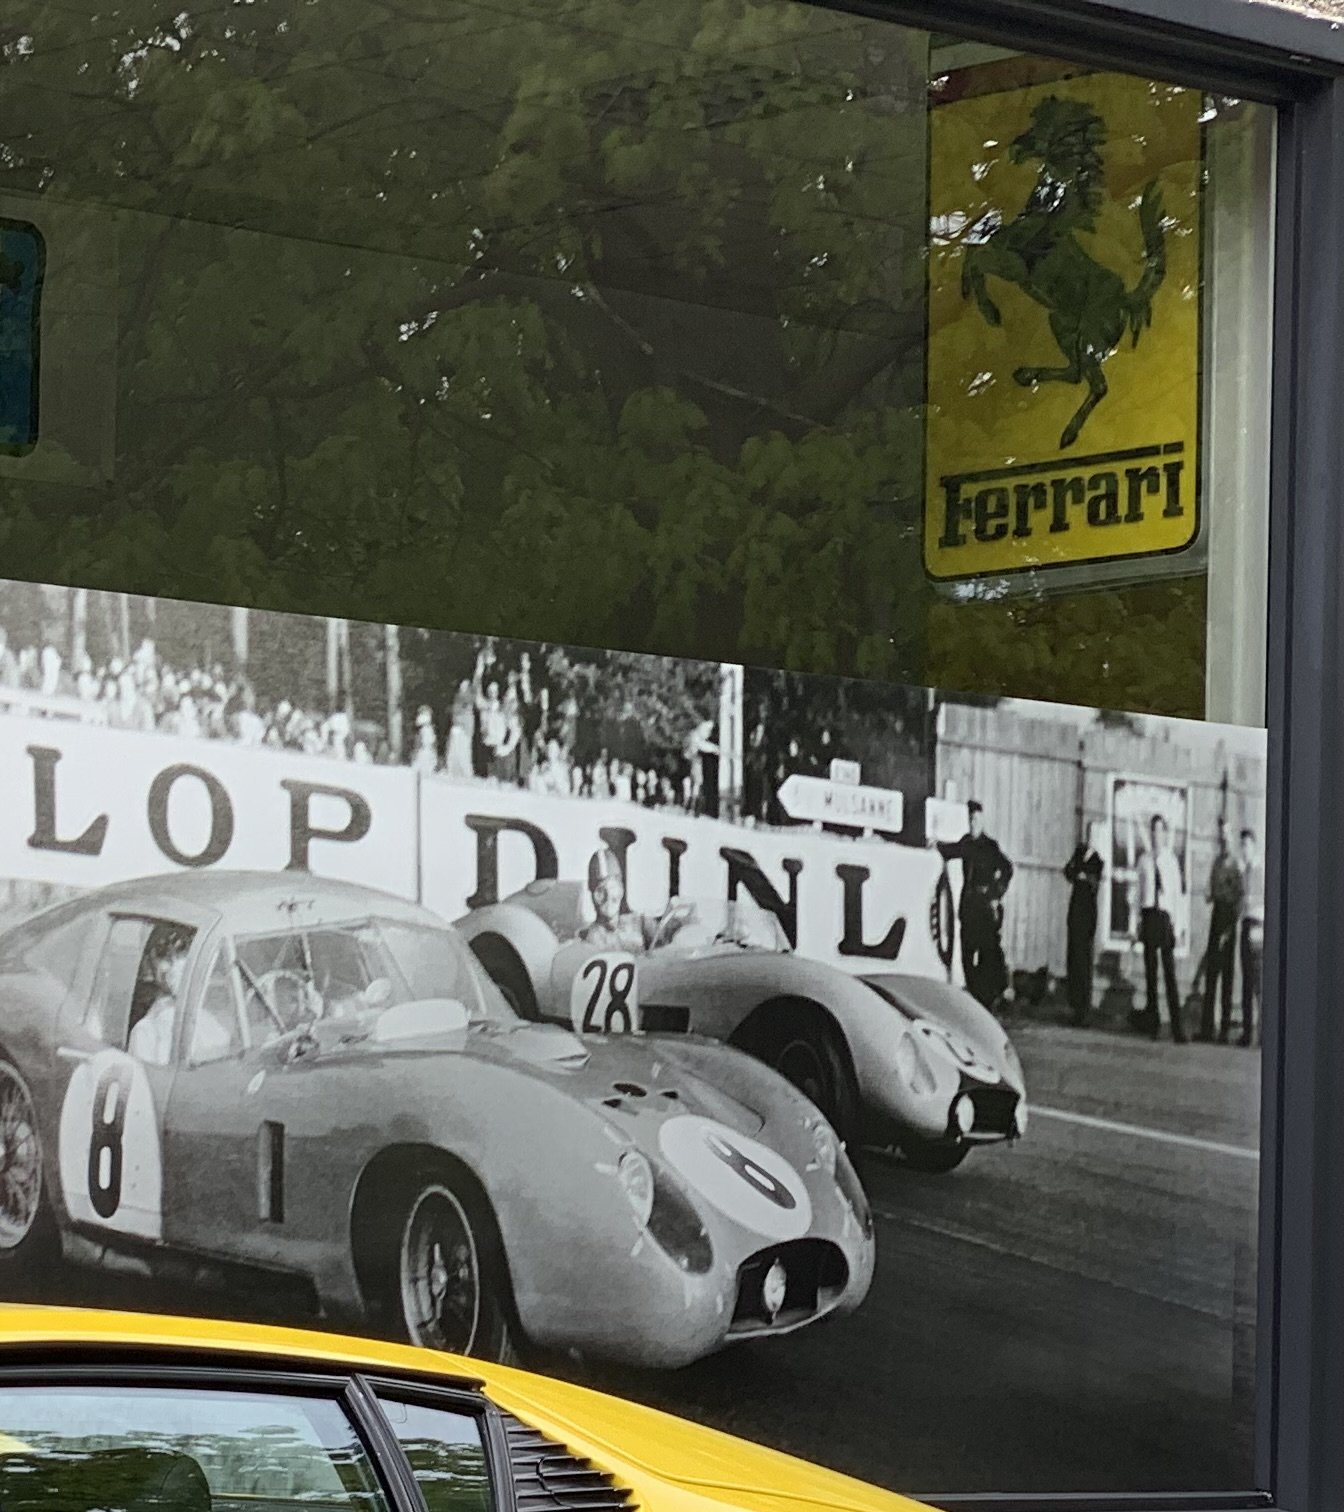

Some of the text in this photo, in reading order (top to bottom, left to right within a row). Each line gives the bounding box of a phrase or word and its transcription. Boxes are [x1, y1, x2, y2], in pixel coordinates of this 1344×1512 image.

[938, 440, 1185, 549] Ferrari
[579, 960, 635, 1033] 28
[88, 1066, 132, 1218] 8
[705, 1131, 797, 1210] 8
